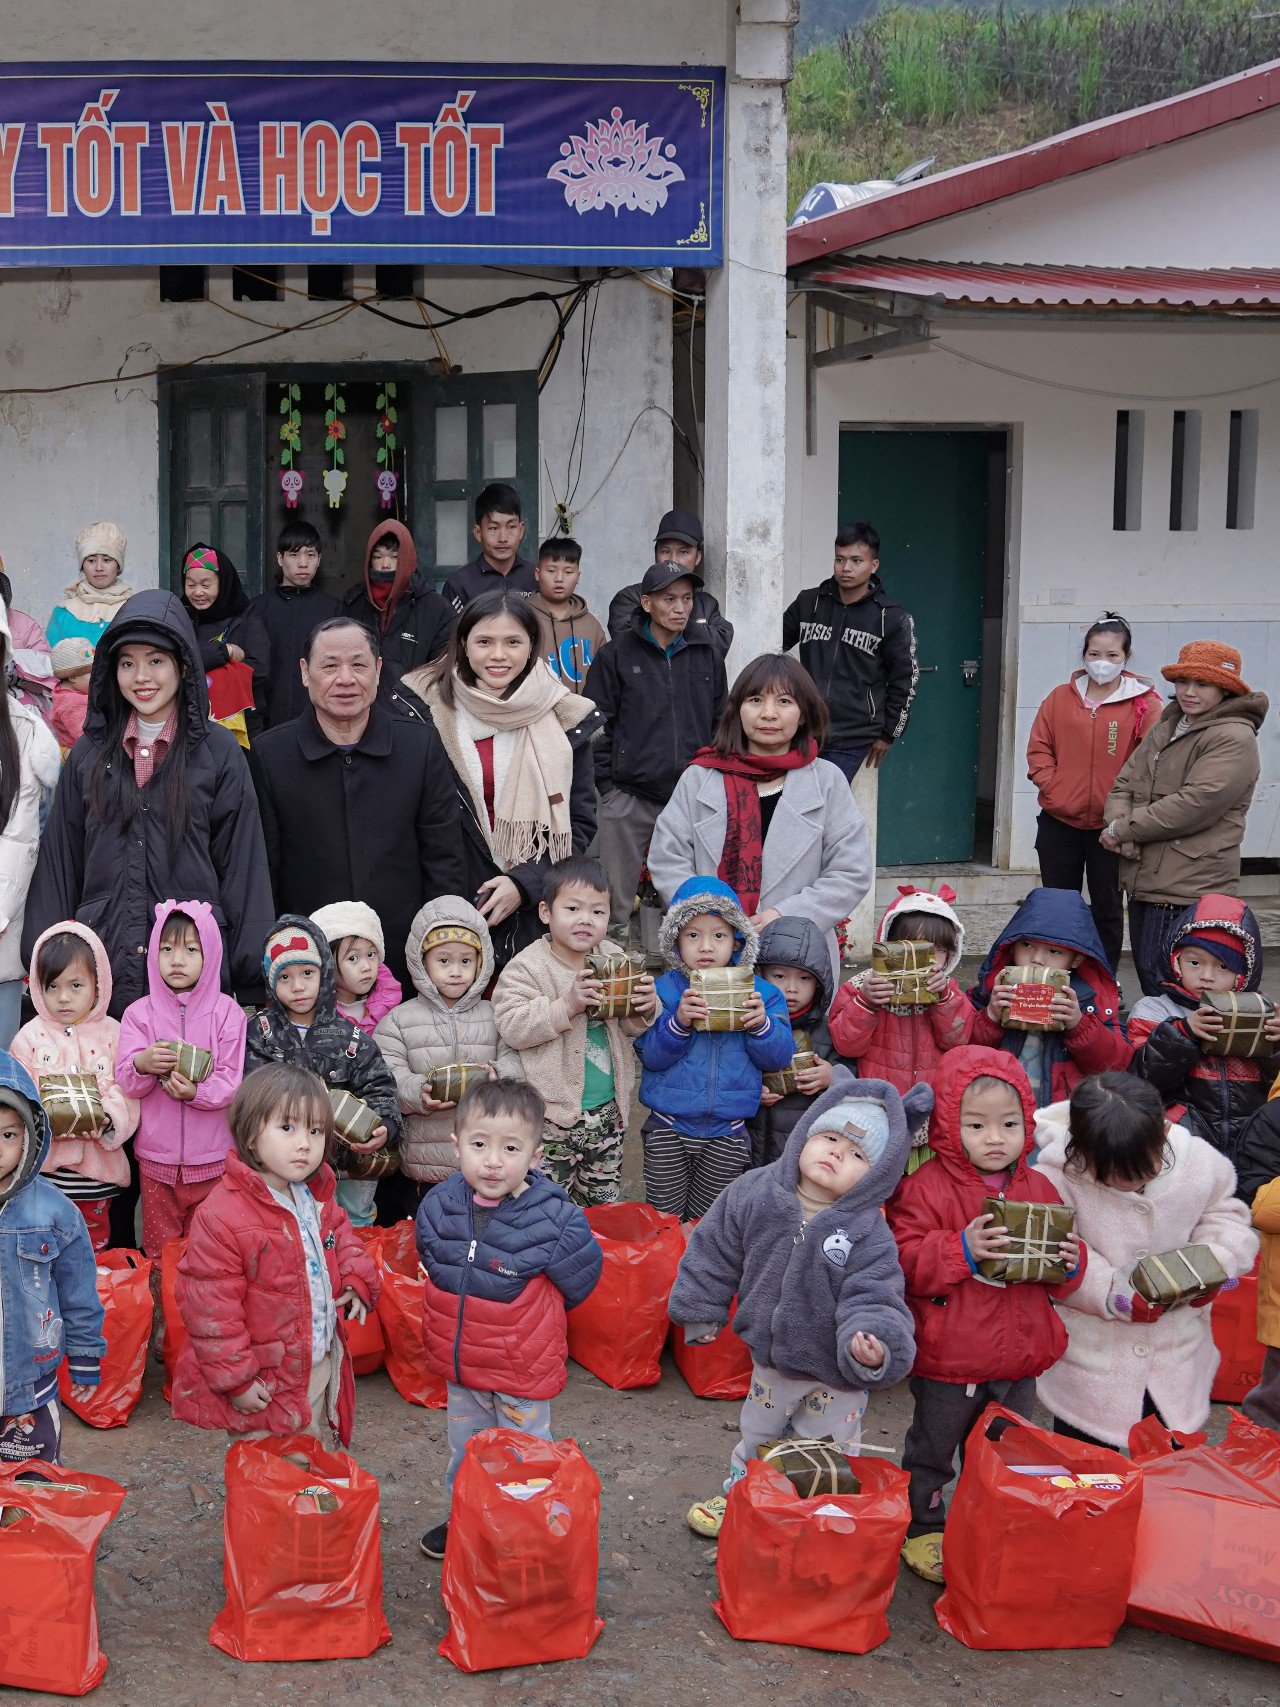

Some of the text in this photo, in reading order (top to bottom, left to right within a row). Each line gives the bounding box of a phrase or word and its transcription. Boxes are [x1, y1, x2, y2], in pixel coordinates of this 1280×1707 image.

[38, 89, 149, 217] TỐT
[162, 101, 246, 215] VÀ
[259, 120, 382, 236] HỌC
[395, 90, 504, 217] TỐT
